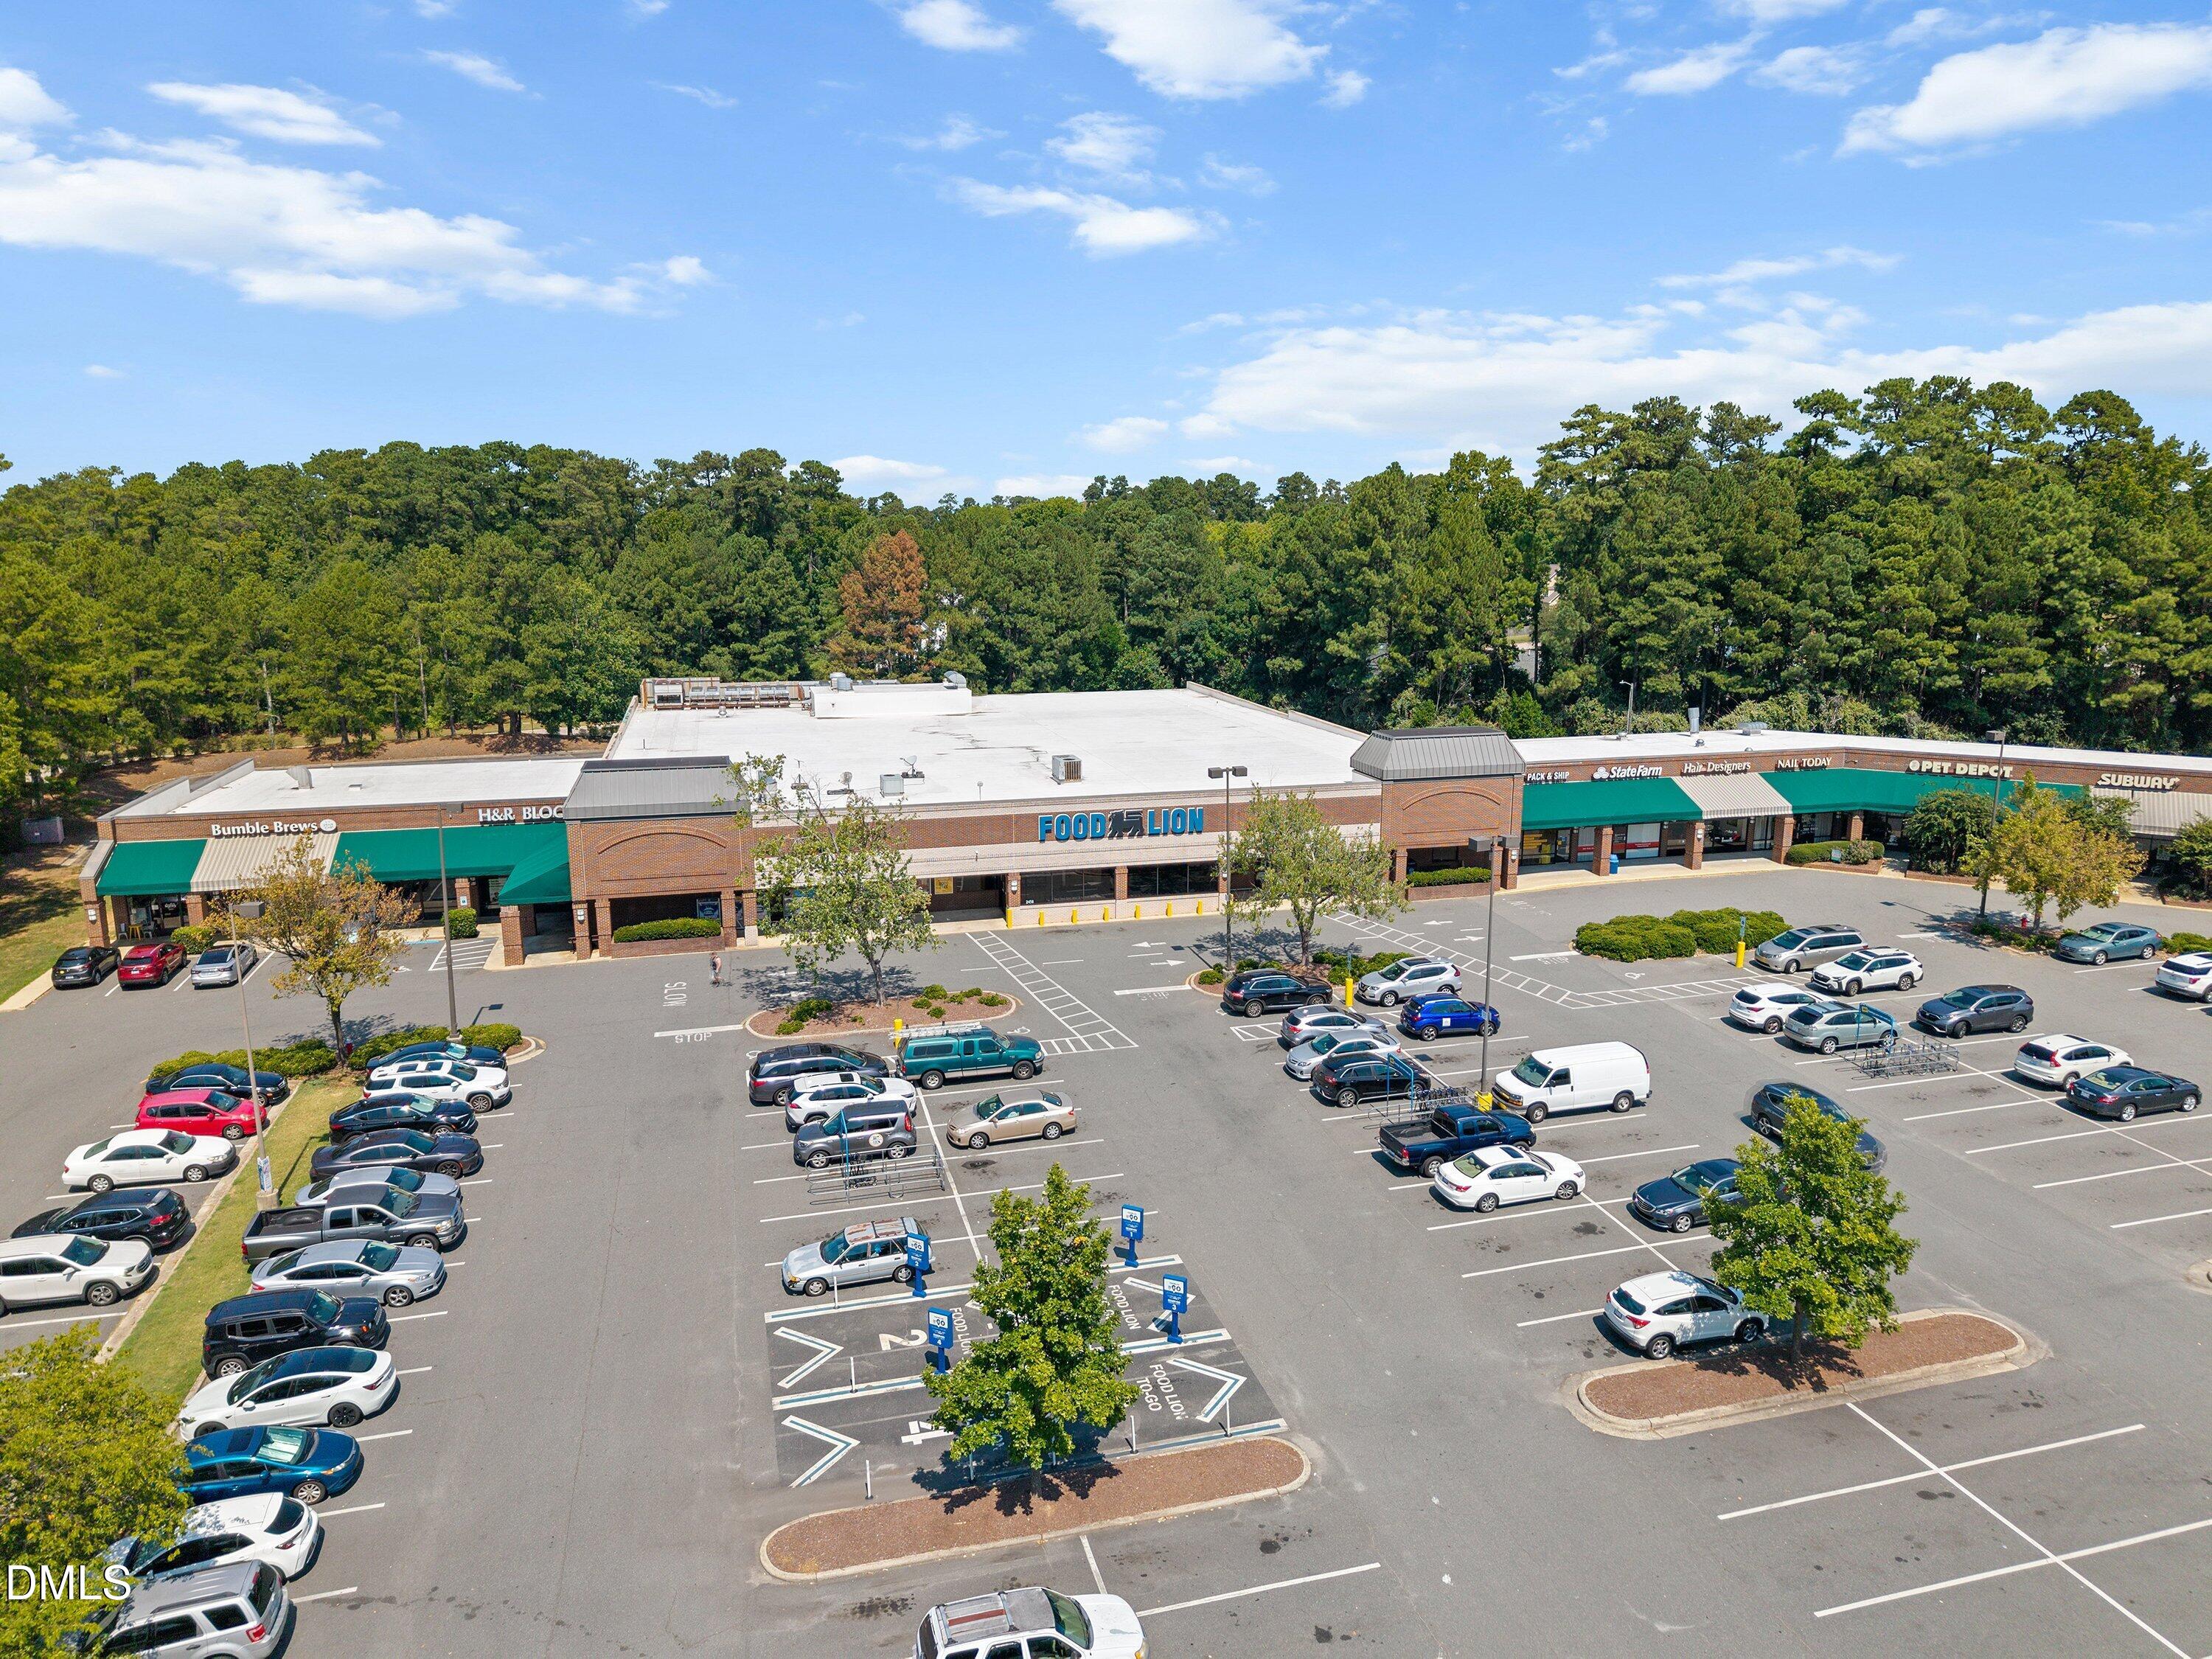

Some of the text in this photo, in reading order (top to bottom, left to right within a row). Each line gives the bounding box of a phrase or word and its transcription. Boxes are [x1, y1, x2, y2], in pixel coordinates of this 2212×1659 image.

[1684, 760, 1751, 773] Hair Designers
[1778, 757, 1832, 768] NAIL TODAY
[1921, 760, 2014, 778] PET DEPOT
[1527, 771, 1570, 781] PACK & SHIP
[2097, 773, 2180, 790] SUBWAY
[478, 804, 564, 822] H&R BLOC
[211, 821, 270, 836] Bumble
[274, 821, 318, 833] Brews
[1038, 807, 1204, 841] FOOD LION
[663, 981, 687, 1006] SLOW
[675, 1032, 712, 1043] STOP
[1108, 1284, 1130, 1308] FOOD
[1121, 1309, 1141, 1330] LION
[878, 1329, 928, 1351] 2
[950, 1307, 973, 1355] FOOD LION
[1136, 1377, 1163, 1411] TO-GO
[1150, 1364, 1189, 1420] FOOD LION
[900, 1420, 954, 1445] 4
